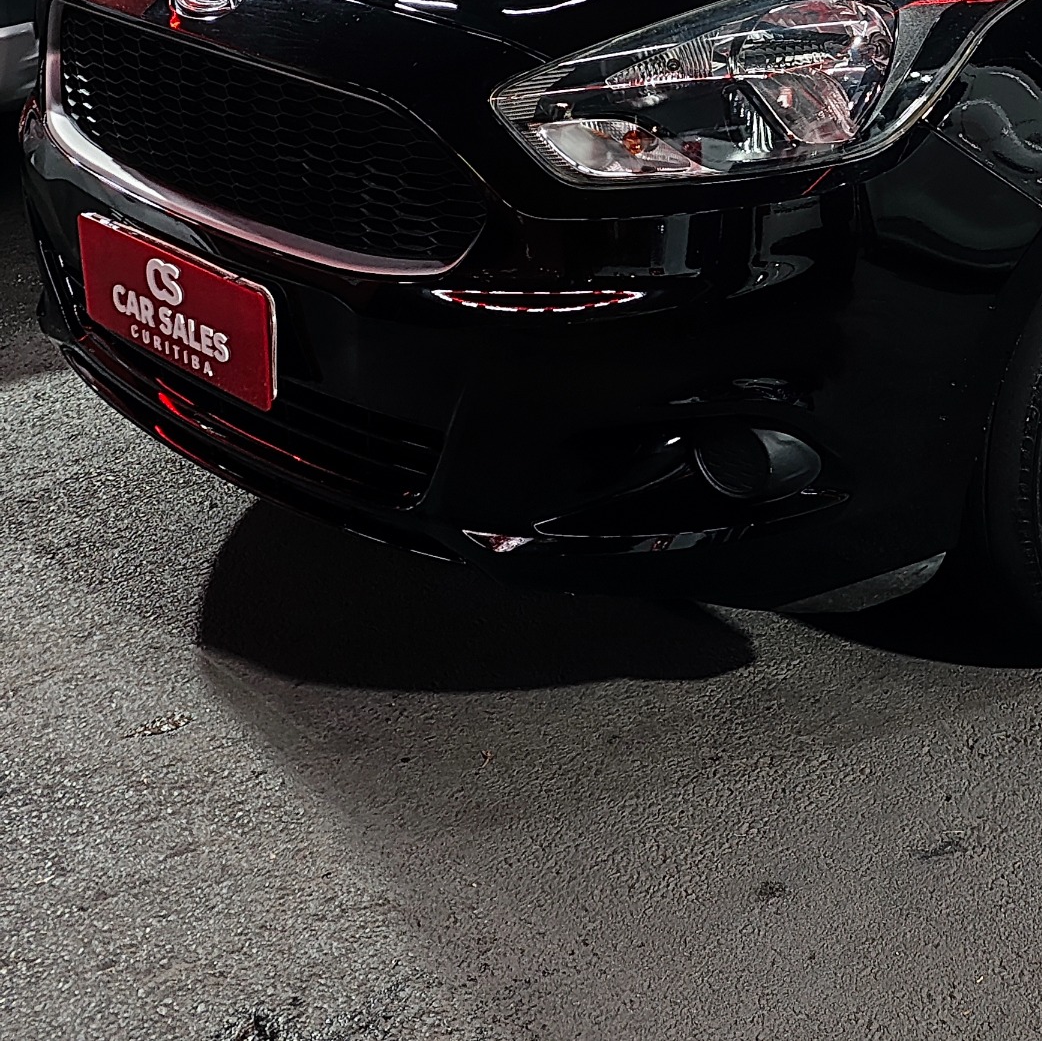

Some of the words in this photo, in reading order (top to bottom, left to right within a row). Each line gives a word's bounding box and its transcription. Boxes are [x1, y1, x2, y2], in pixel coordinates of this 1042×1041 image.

[145, 258, 183, 306] CS
[112, 284, 156, 328] CAR
[158, 306, 231, 363] SALES
[130, 324, 214, 378] CURITIBA
